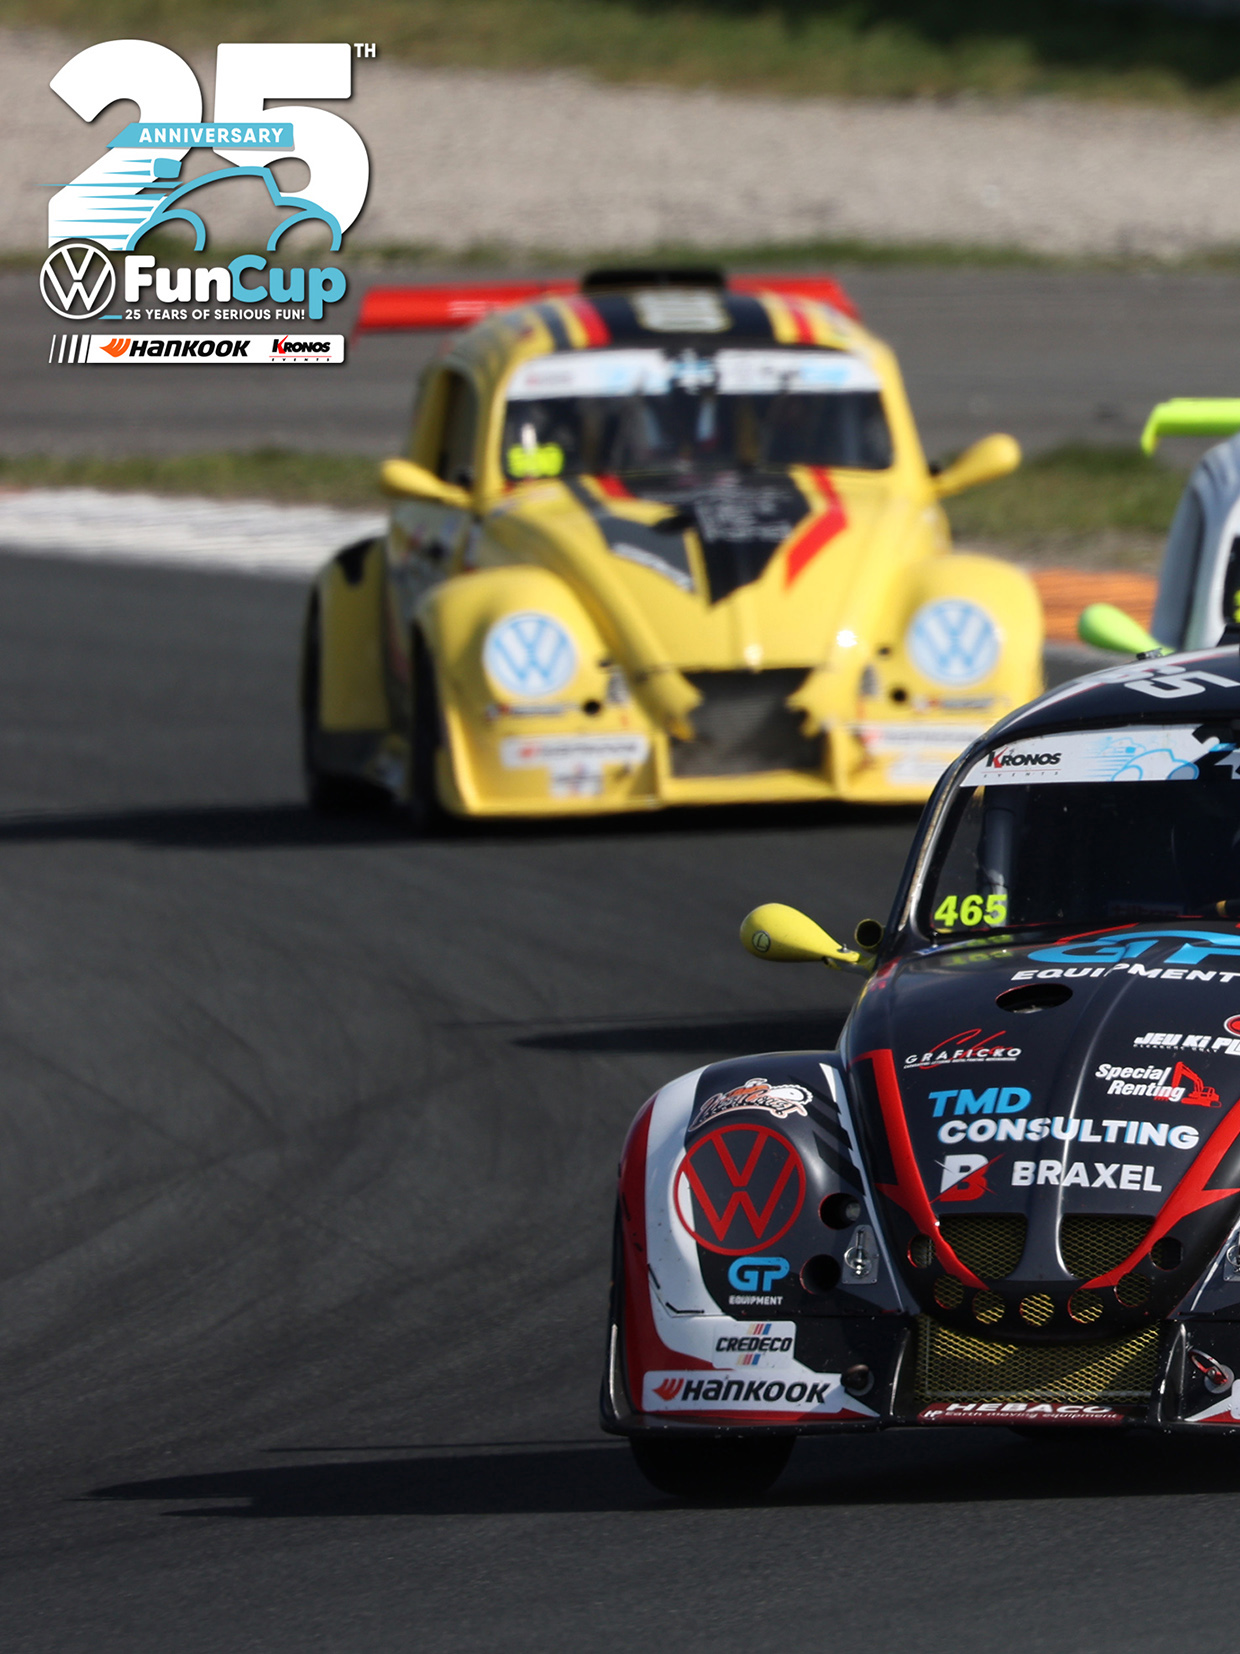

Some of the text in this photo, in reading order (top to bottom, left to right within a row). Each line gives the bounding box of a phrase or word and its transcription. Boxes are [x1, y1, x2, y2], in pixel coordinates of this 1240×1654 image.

[985, 747, 1062, 769] KRONOS
[934, 894, 1007, 927] 465
[1133, 1032, 1183, 1046] JEU
[905, 1048, 1022, 1064] GRAFICKO
[1095, 1063, 1172, 1086] Special
[928, 1087, 1031, 1117] TMD
[1107, 1080, 1186, 1103] Renting
[938, 1115, 1199, 1150] CONSULTING
[1011, 1158, 1163, 1193] BRAXEL
[728, 1256, 790, 1292] GP
[728, 1295, 783, 1305] EQUIPMENT
[715, 1336, 793, 1352] CREDECO
[946, 1403, 1113, 1414] HEBACO
